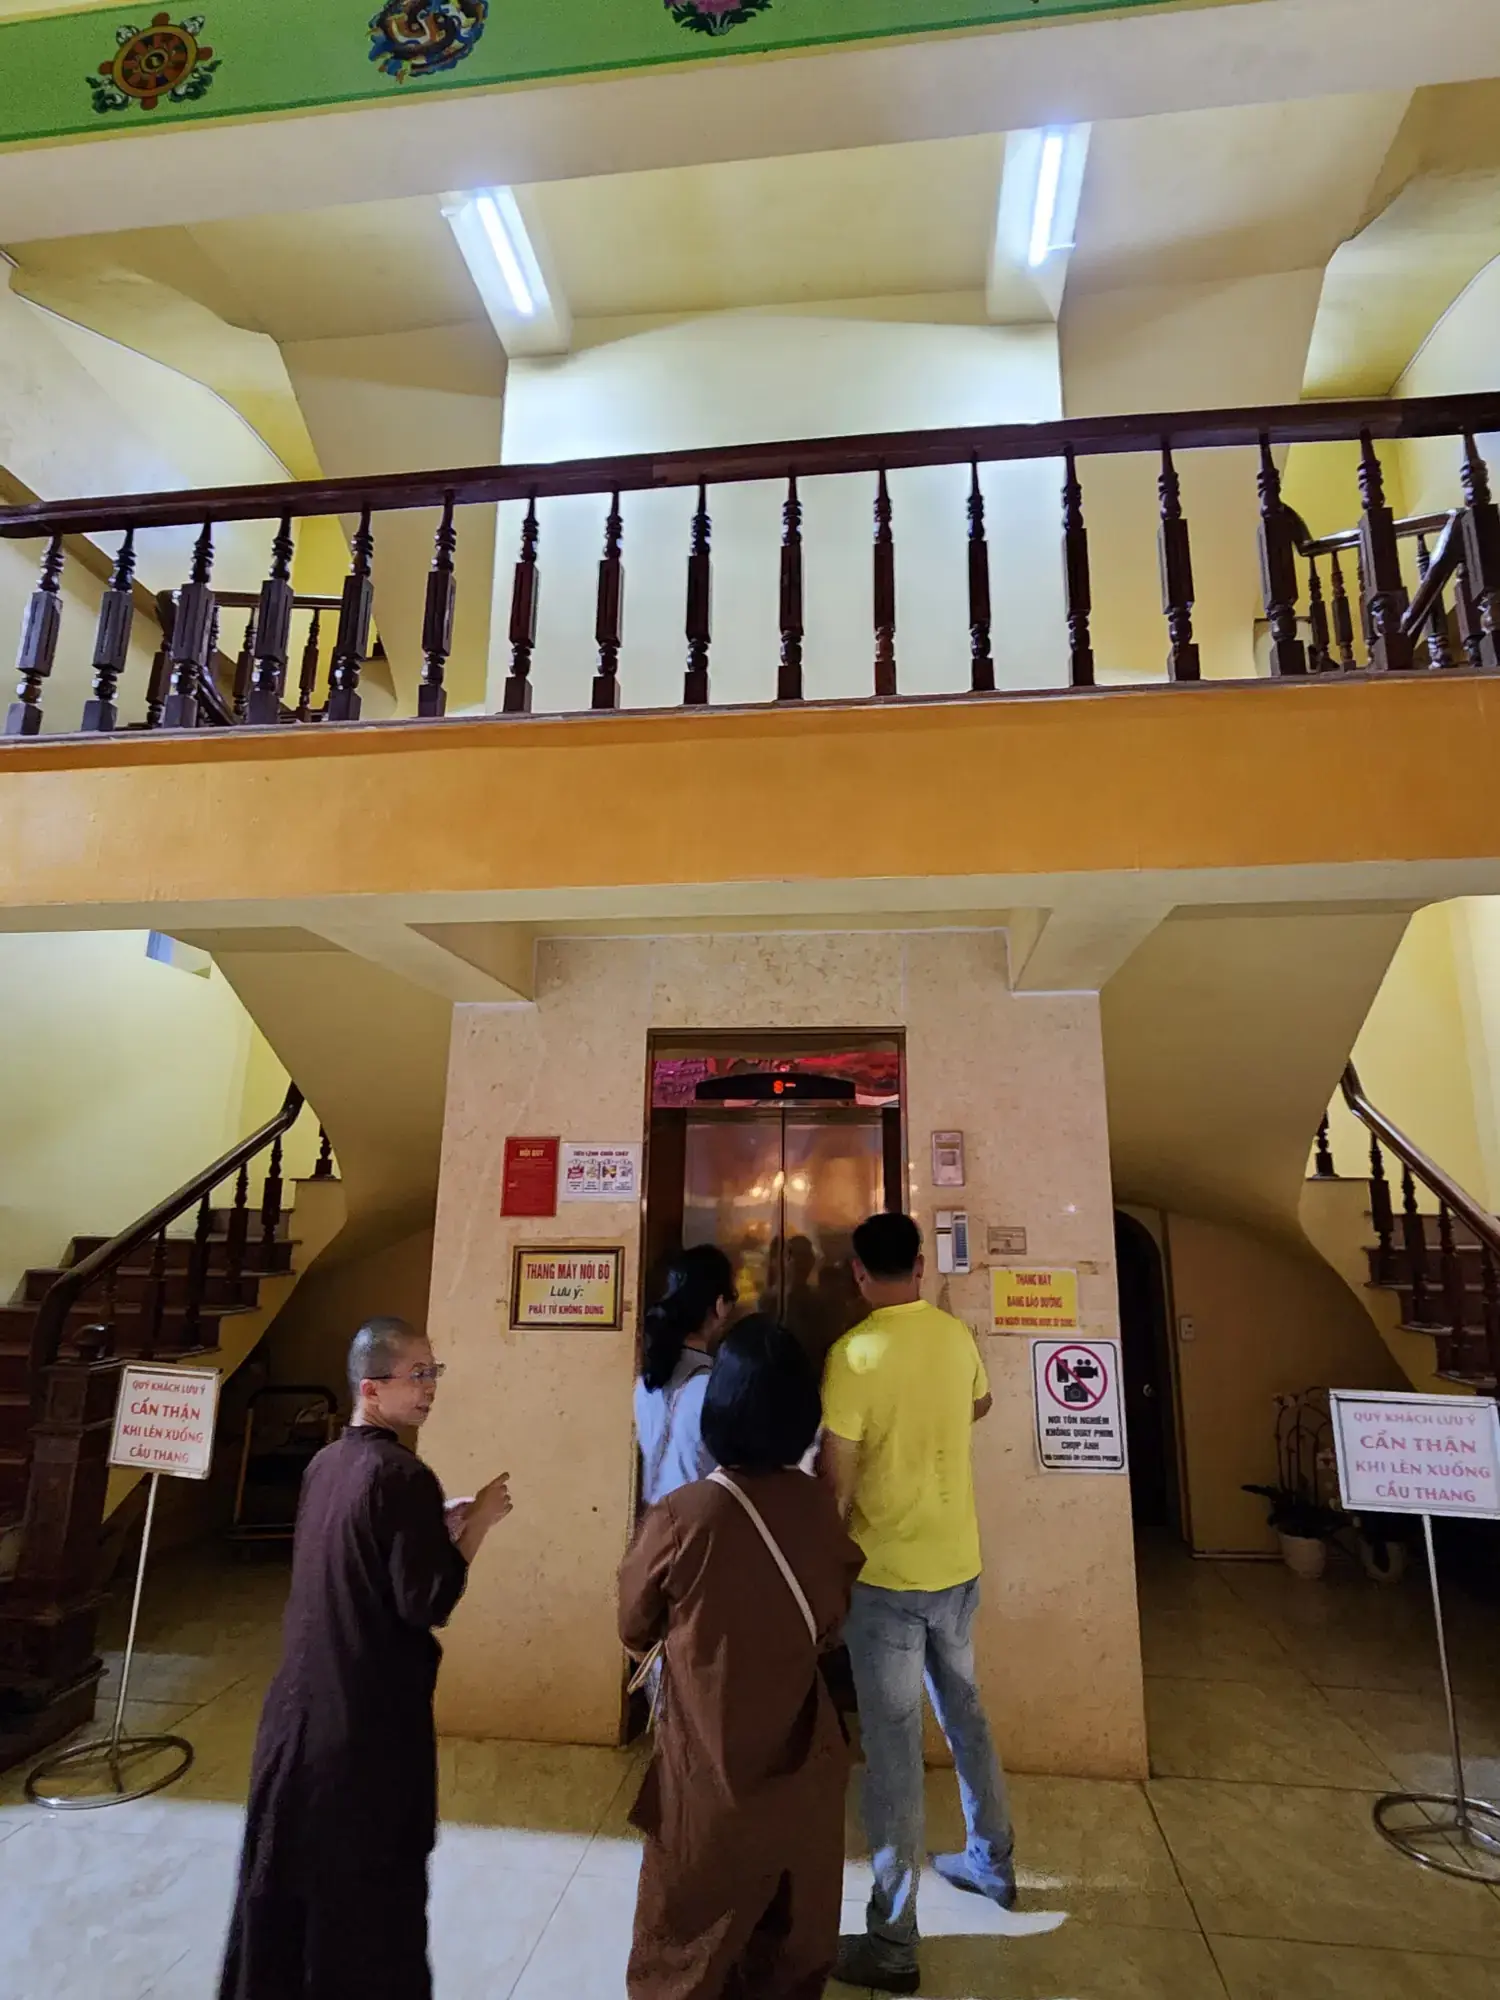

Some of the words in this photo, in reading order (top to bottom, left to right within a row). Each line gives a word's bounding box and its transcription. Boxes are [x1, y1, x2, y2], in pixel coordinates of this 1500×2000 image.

[527, 1264, 555, 1279] THANG
[558, 1260, 577, 1279] MÁY
[580, 1260, 596, 1283] NỘI
[598, 1260, 610, 1283] BỘ
[151, 1381, 180, 1391] KHÁCH
[162, 1403, 201, 1422] THẬN
[1384, 1411, 1433, 1424] KHÁCH
[122, 1424, 141, 1436] KHI
[143, 1425, 162, 1438] LÊN
[164, 1427, 204, 1443] XUỐNG
[1360, 1429, 1407, 1450] CẨN
[1412, 1436, 1477, 1456] THẬN
[153, 1449, 188, 1463] THANG
[1356, 1460, 1386, 1473] KHI
[1390, 1459, 1422, 1475] LÊN
[1426, 1460, 1491, 1479] XUỐNG
[1414, 1486, 1477, 1503] THANG
